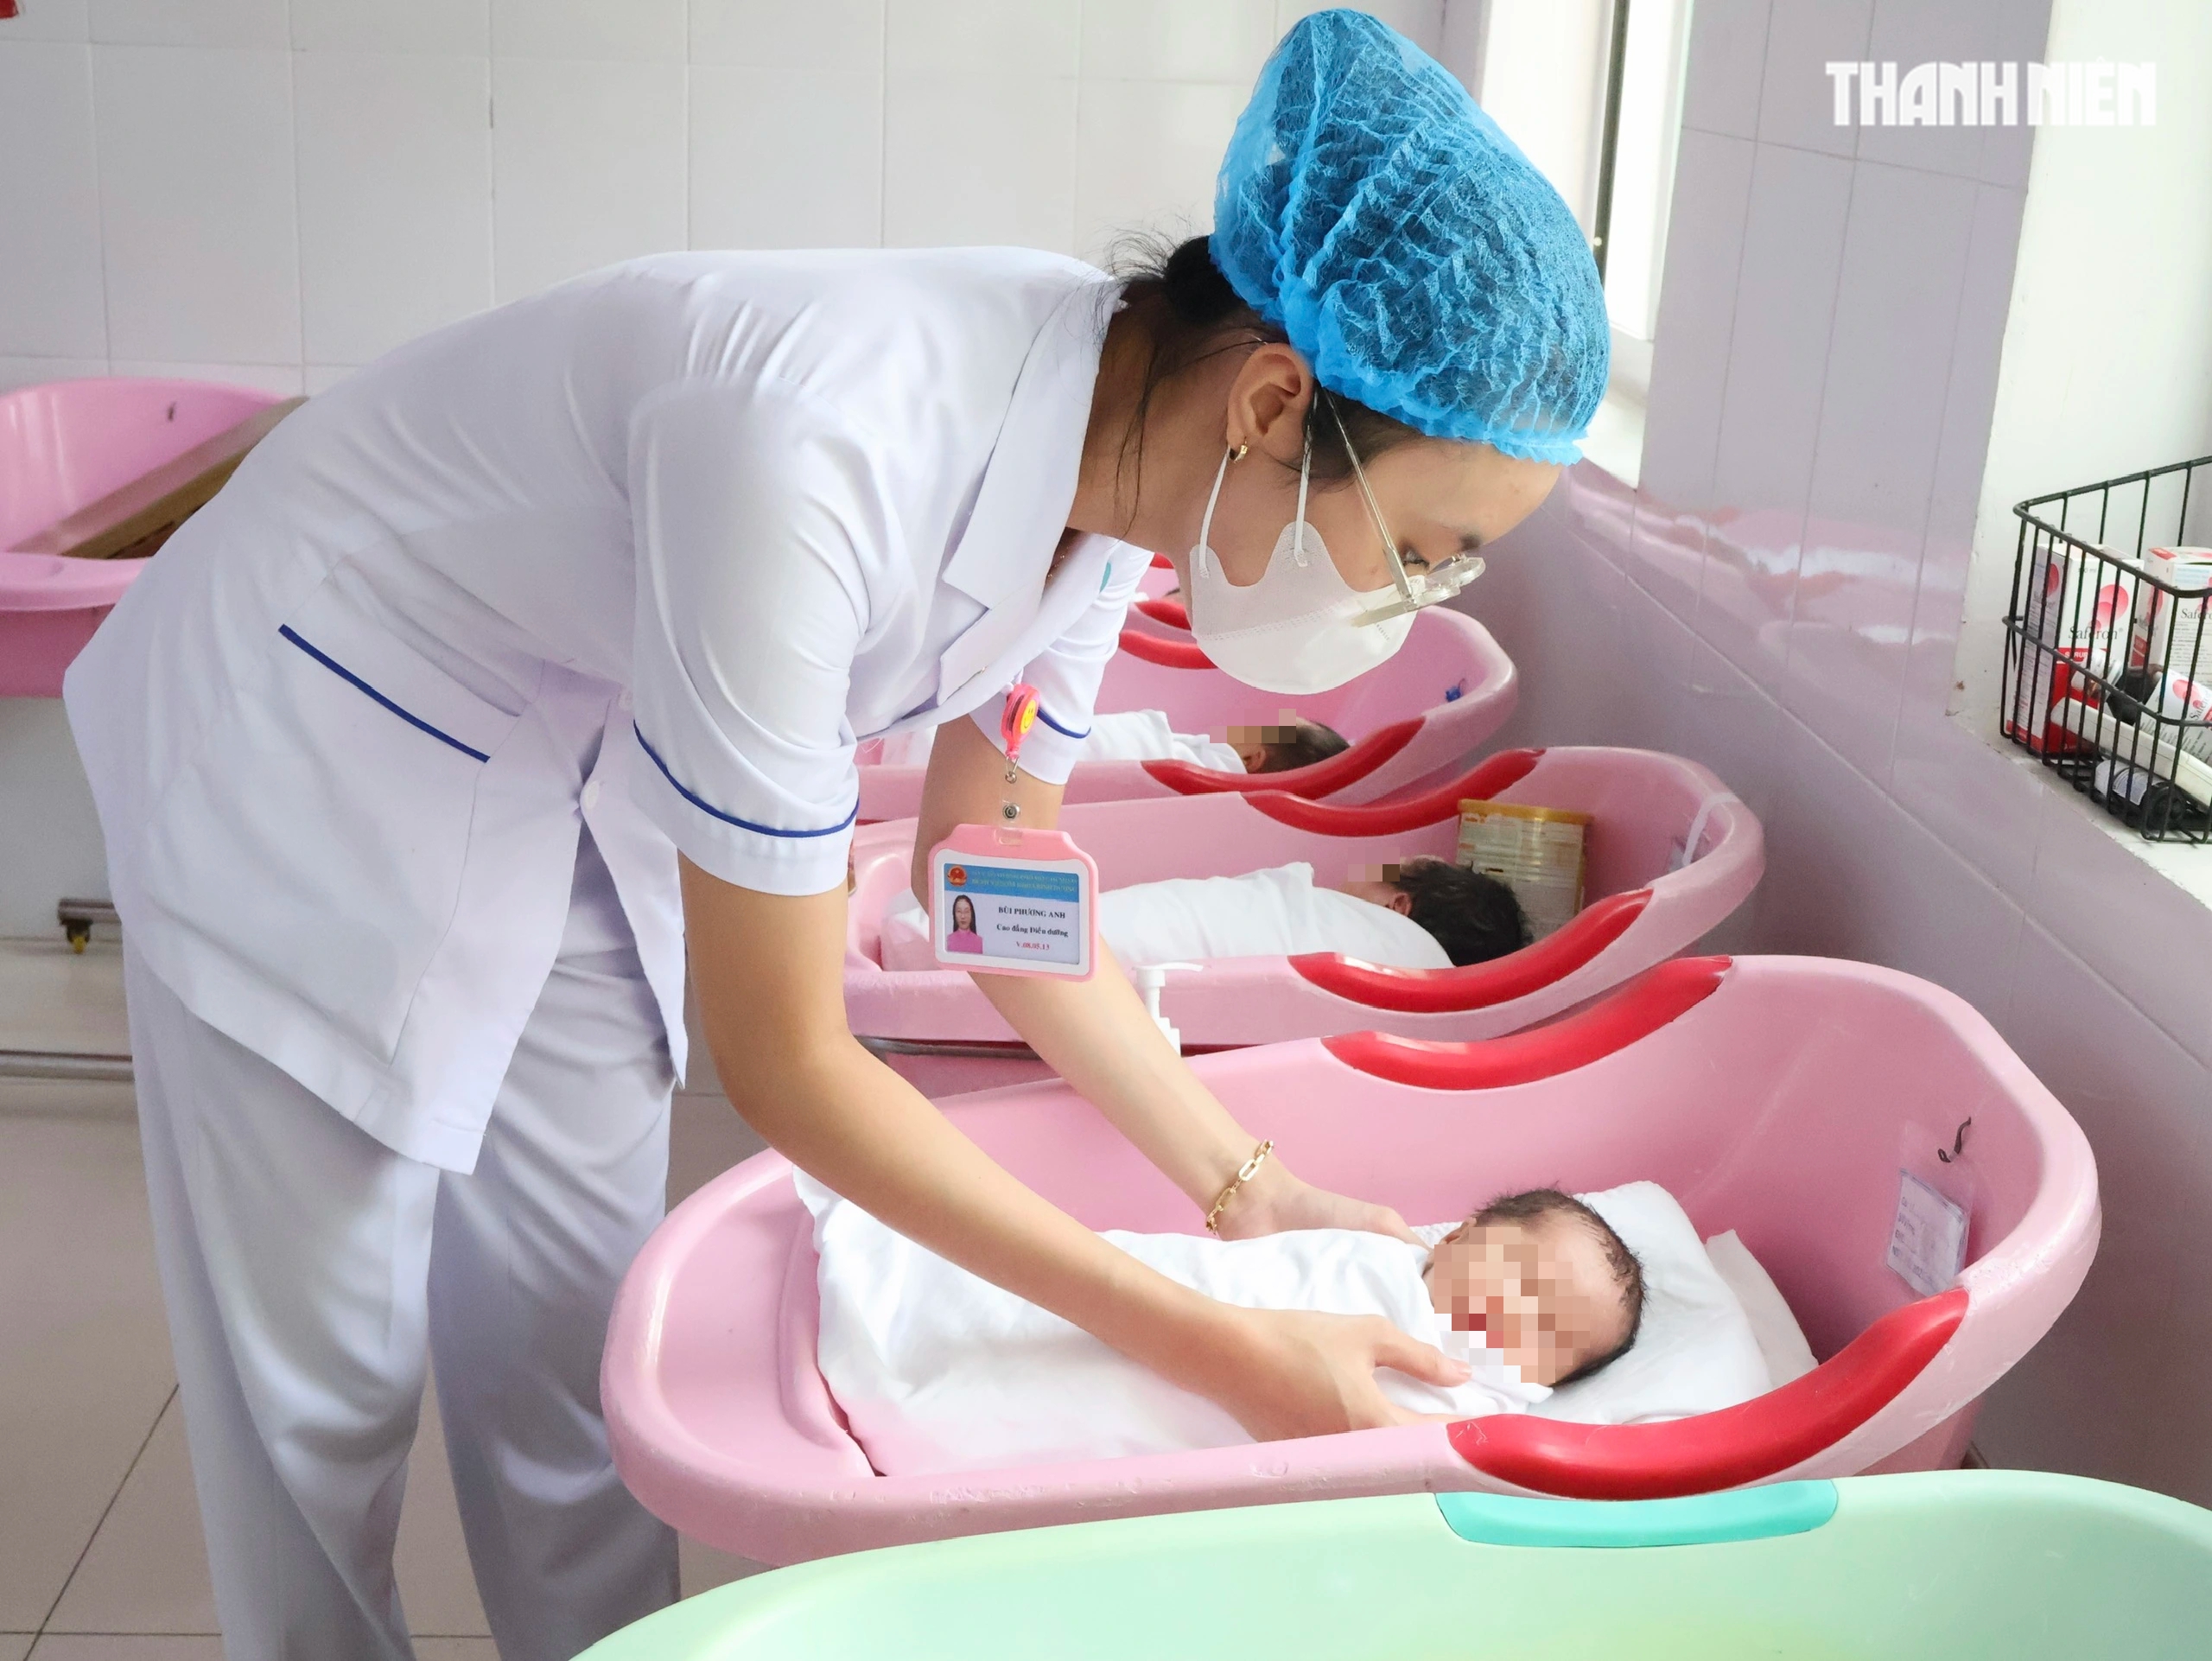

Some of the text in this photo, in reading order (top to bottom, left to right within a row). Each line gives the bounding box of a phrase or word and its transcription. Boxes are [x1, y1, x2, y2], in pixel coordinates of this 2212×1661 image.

[2068, 626, 2118, 640] Safron
[998, 905, 1065, 920] BÙI PHƯƠNG ANH
[996, 922, 1010, 932] Cao
[1011, 924, 1028, 934] đẳng
[1046, 928, 1069, 938] dưỡng
